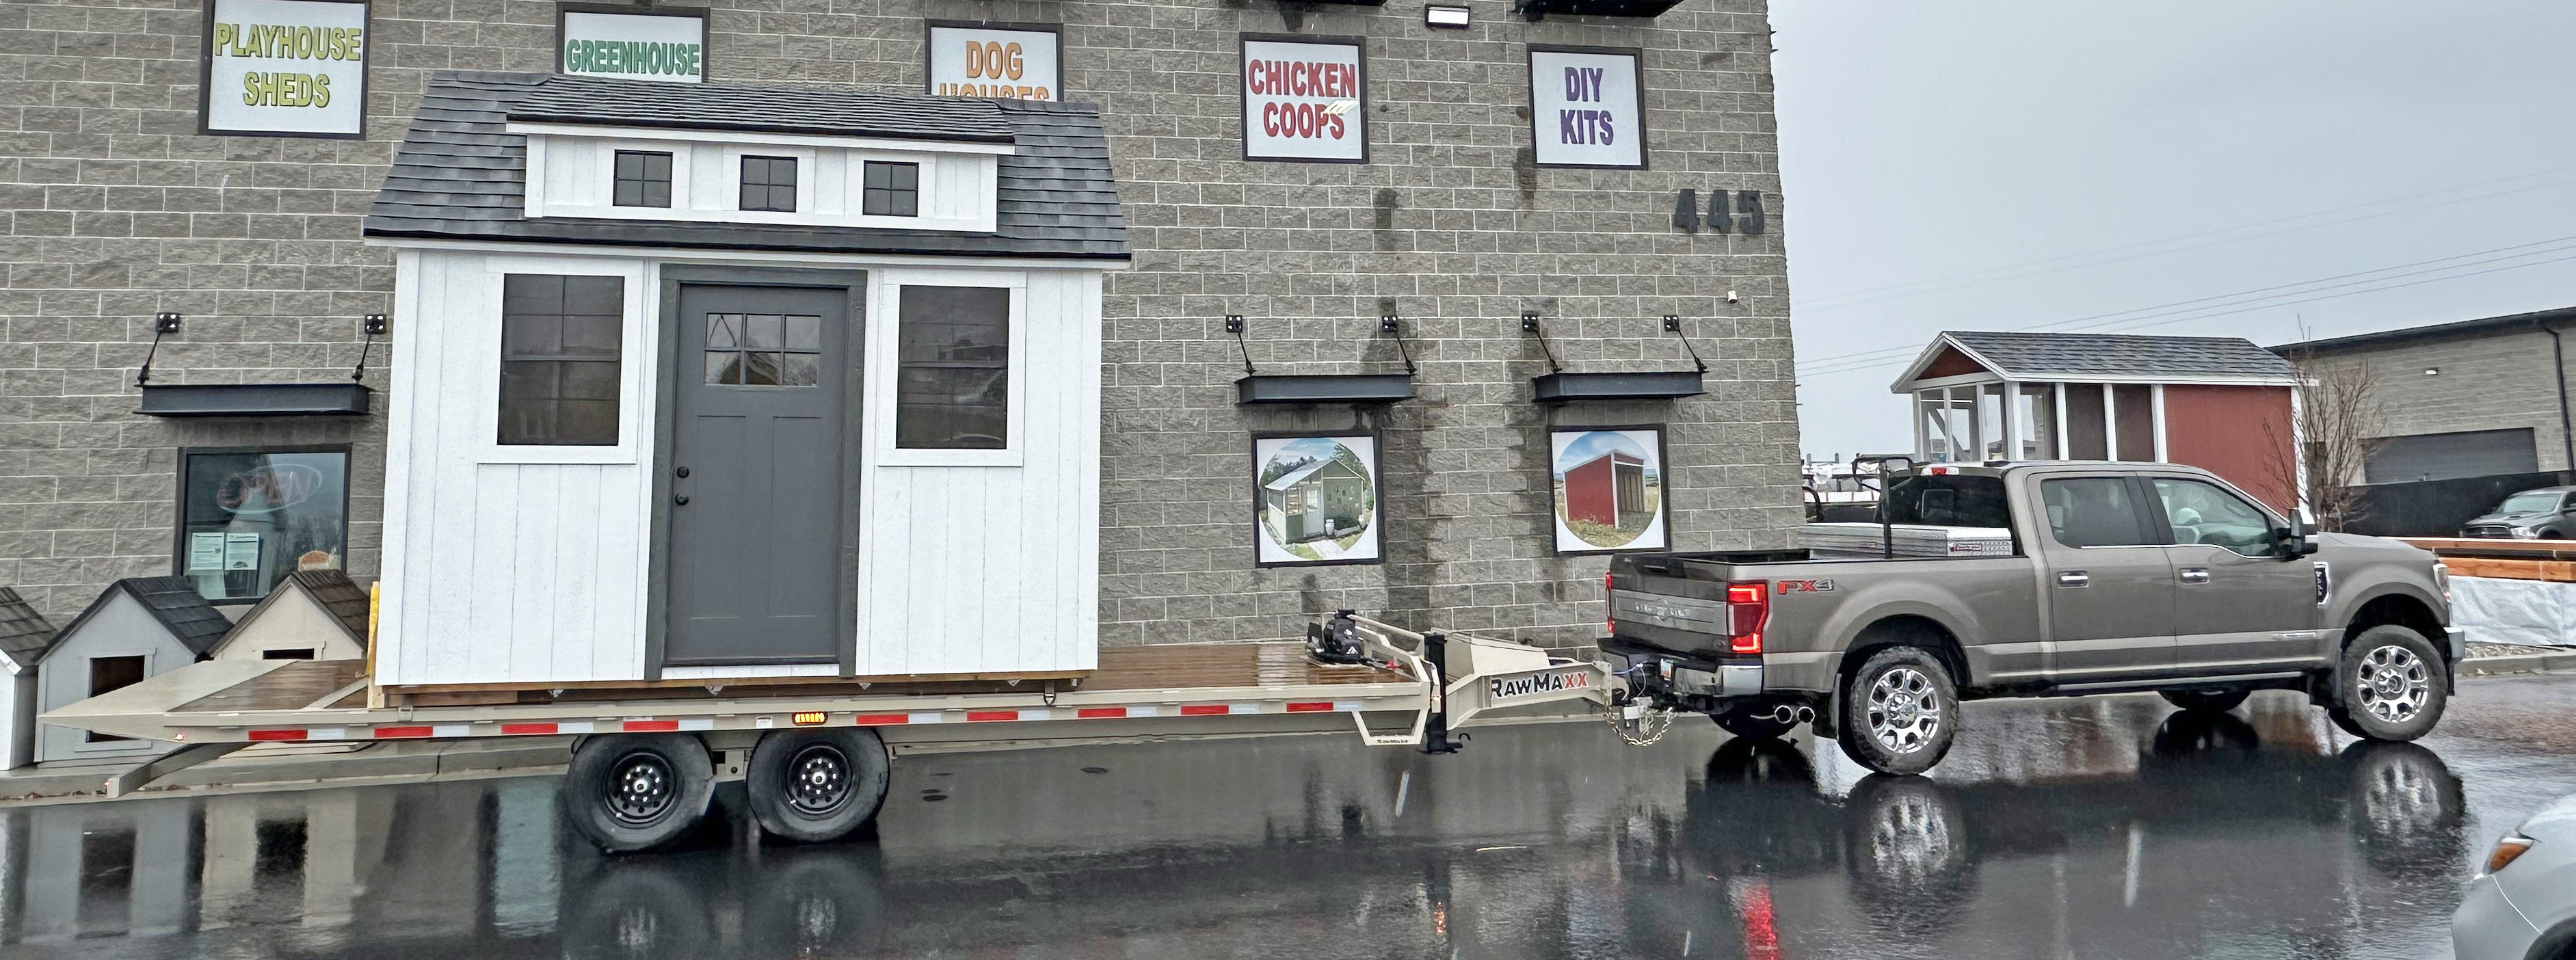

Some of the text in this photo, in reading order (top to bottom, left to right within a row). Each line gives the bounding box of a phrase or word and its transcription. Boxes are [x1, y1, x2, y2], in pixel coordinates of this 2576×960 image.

[215, 23, 362, 61] PLAYHOUSE
[566, 39, 700, 75] GREENHOUSE
[966, 40, 1023, 81] DOG
[243, 71, 330, 109] SHEDS
[1249, 59, 1356, 98] CHICKEN
[1565, 66, 1604, 103] DIY
[1263, 101, 1344, 140] COOPS
[1560, 109, 1614, 146] KITS
[1673, 188, 1766, 235] 445
[1777, 579, 1834, 595] FX4
